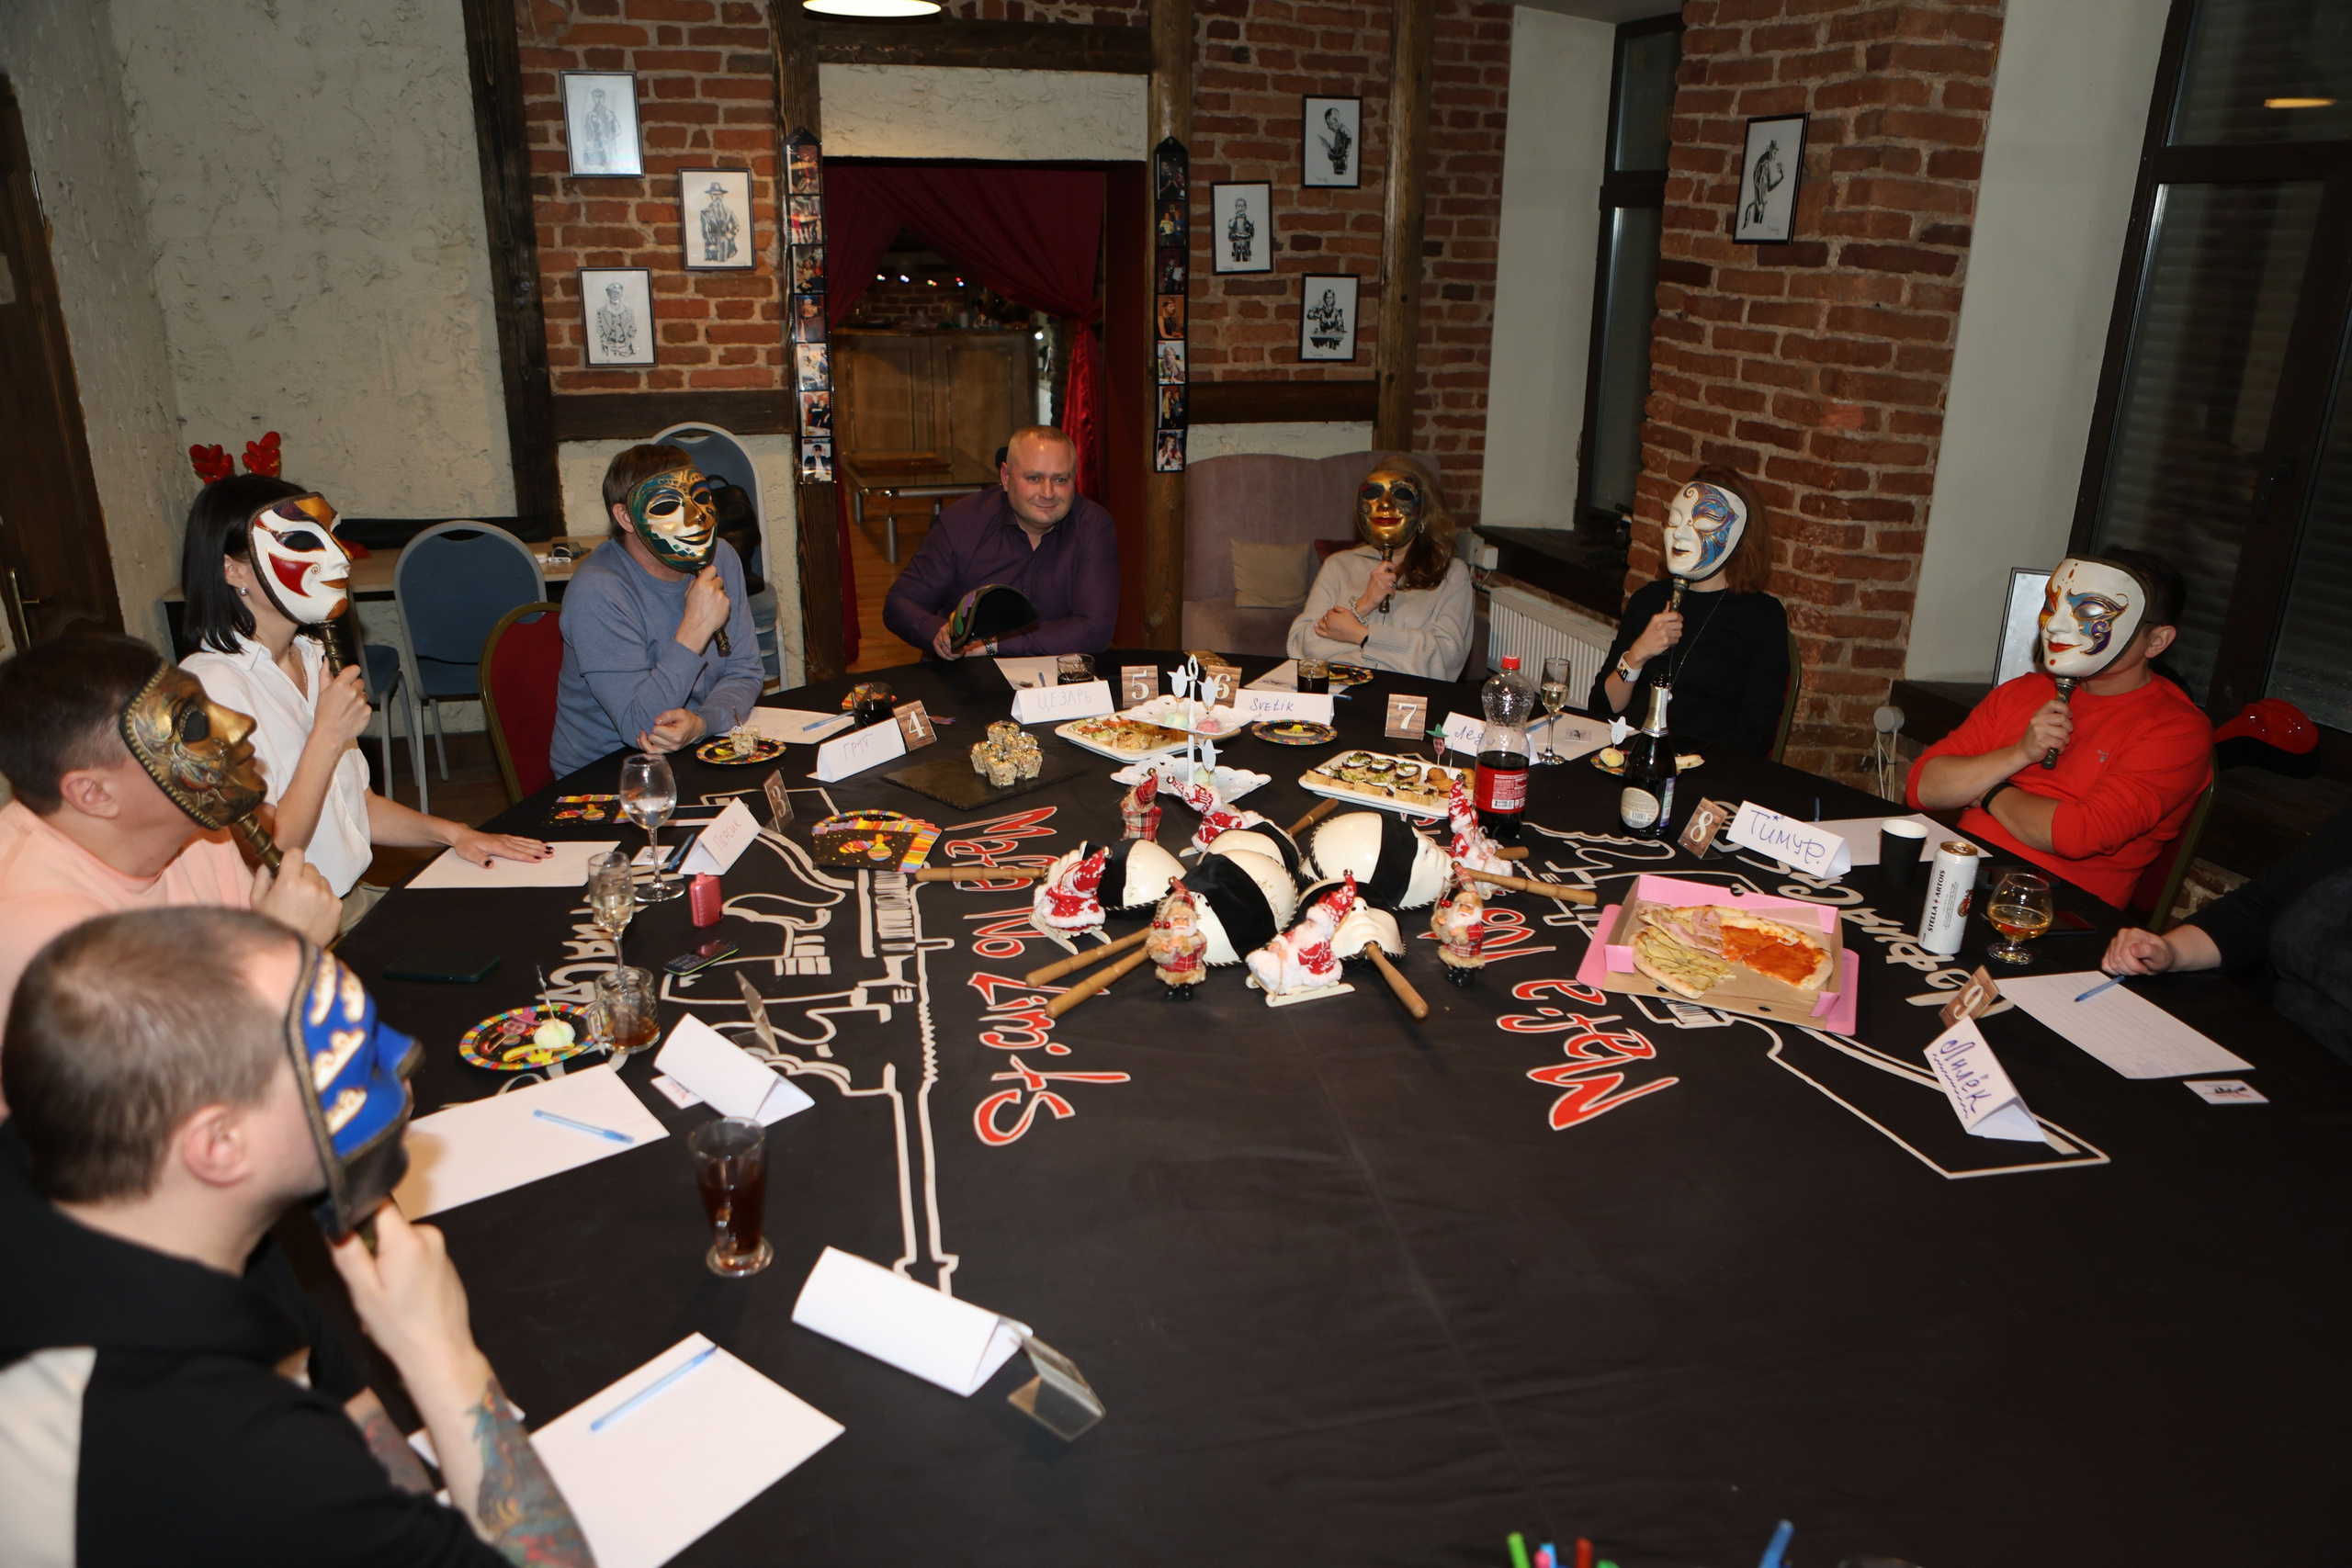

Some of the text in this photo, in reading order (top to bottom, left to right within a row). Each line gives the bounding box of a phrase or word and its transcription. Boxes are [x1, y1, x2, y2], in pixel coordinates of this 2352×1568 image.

[1131, 670, 1149, 700] 5
[1213, 673, 1231, 699] 6
[1037, 690, 1092, 713] ЦЕЗАРЬ
[1397, 703, 1418, 730] 7
[909, 710, 926, 739] 4
[772, 785, 786, 818] 3
[1690, 811, 1713, 842] 8
[1927, 869, 1946, 933] STELLA ARTOIS
[1953, 985, 1984, 1021] 9
